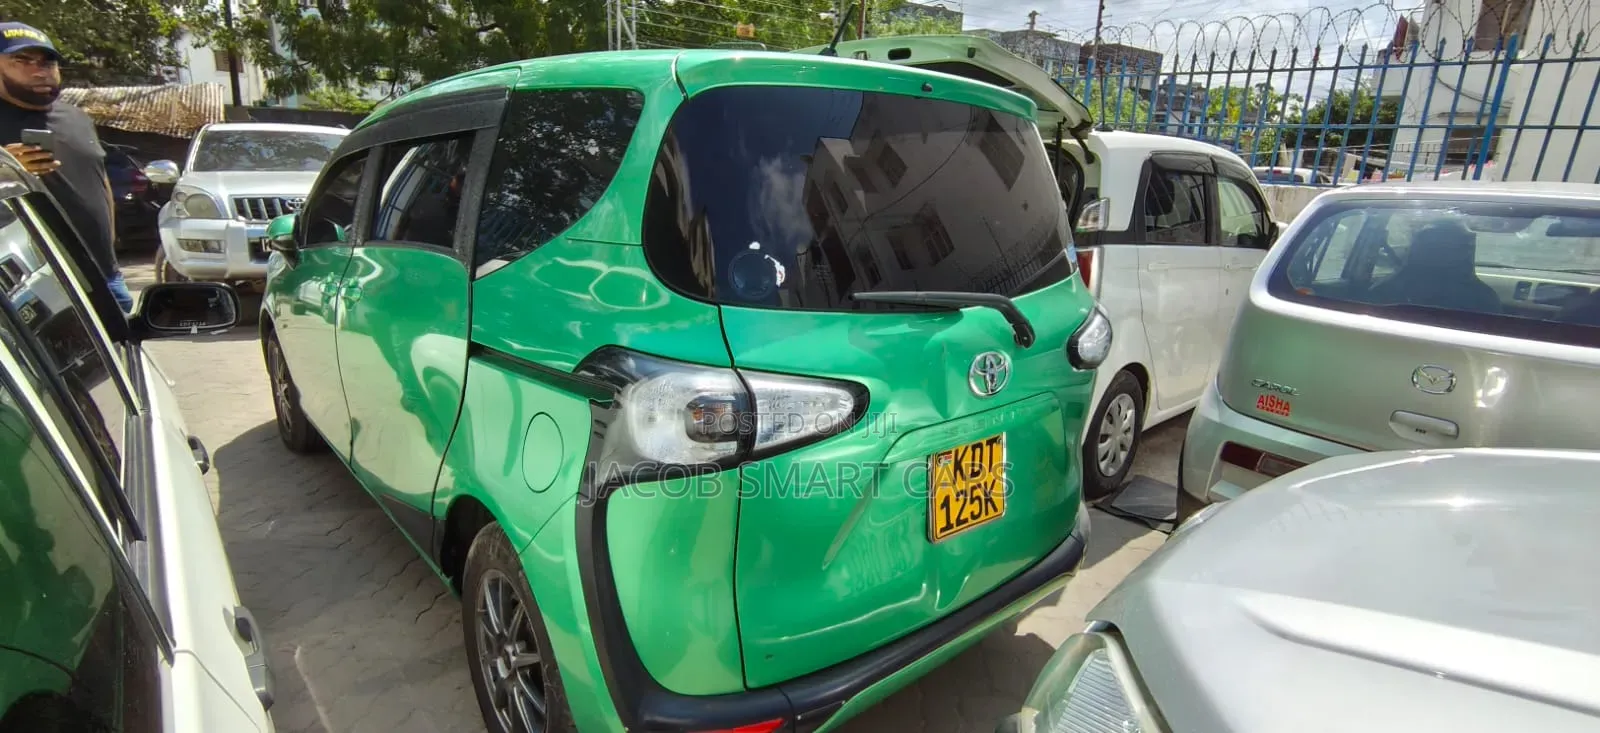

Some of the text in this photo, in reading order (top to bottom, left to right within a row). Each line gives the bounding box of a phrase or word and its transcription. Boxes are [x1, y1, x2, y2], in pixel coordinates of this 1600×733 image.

[1257, 394, 1290, 412] AISHA
[954, 435, 1003, 485] KDT
[940, 479, 998, 533] 125K
